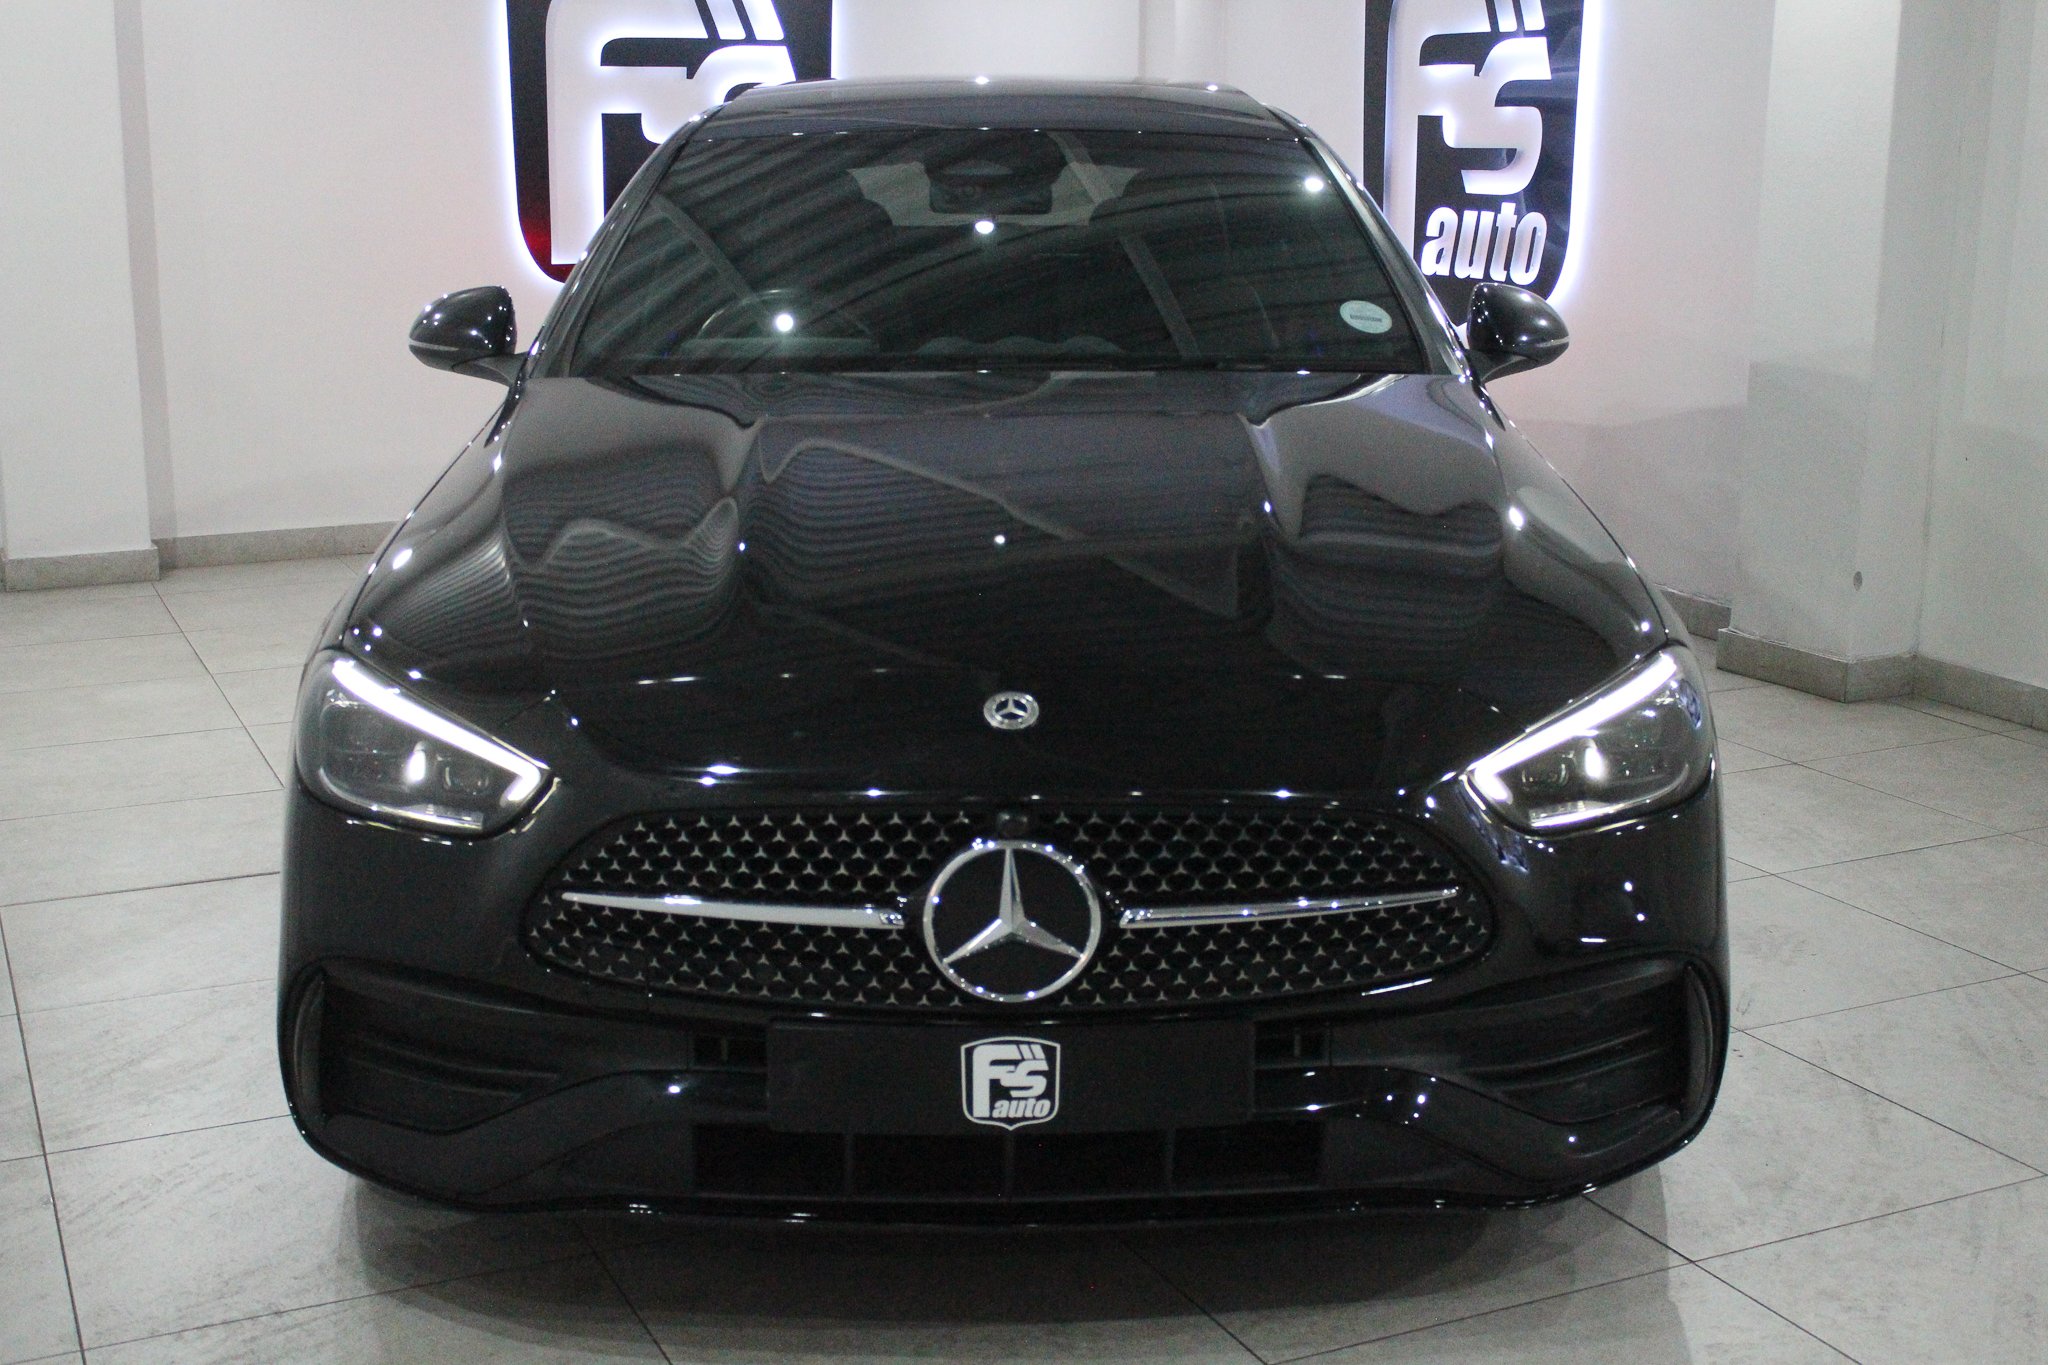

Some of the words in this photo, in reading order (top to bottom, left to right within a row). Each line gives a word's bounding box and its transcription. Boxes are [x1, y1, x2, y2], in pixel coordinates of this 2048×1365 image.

[1383, 0, 1552, 259] FS
[1421, 202, 1547, 285] auto
[972, 1044, 1049, 1118] FS
[992, 1098, 1051, 1118] auto
